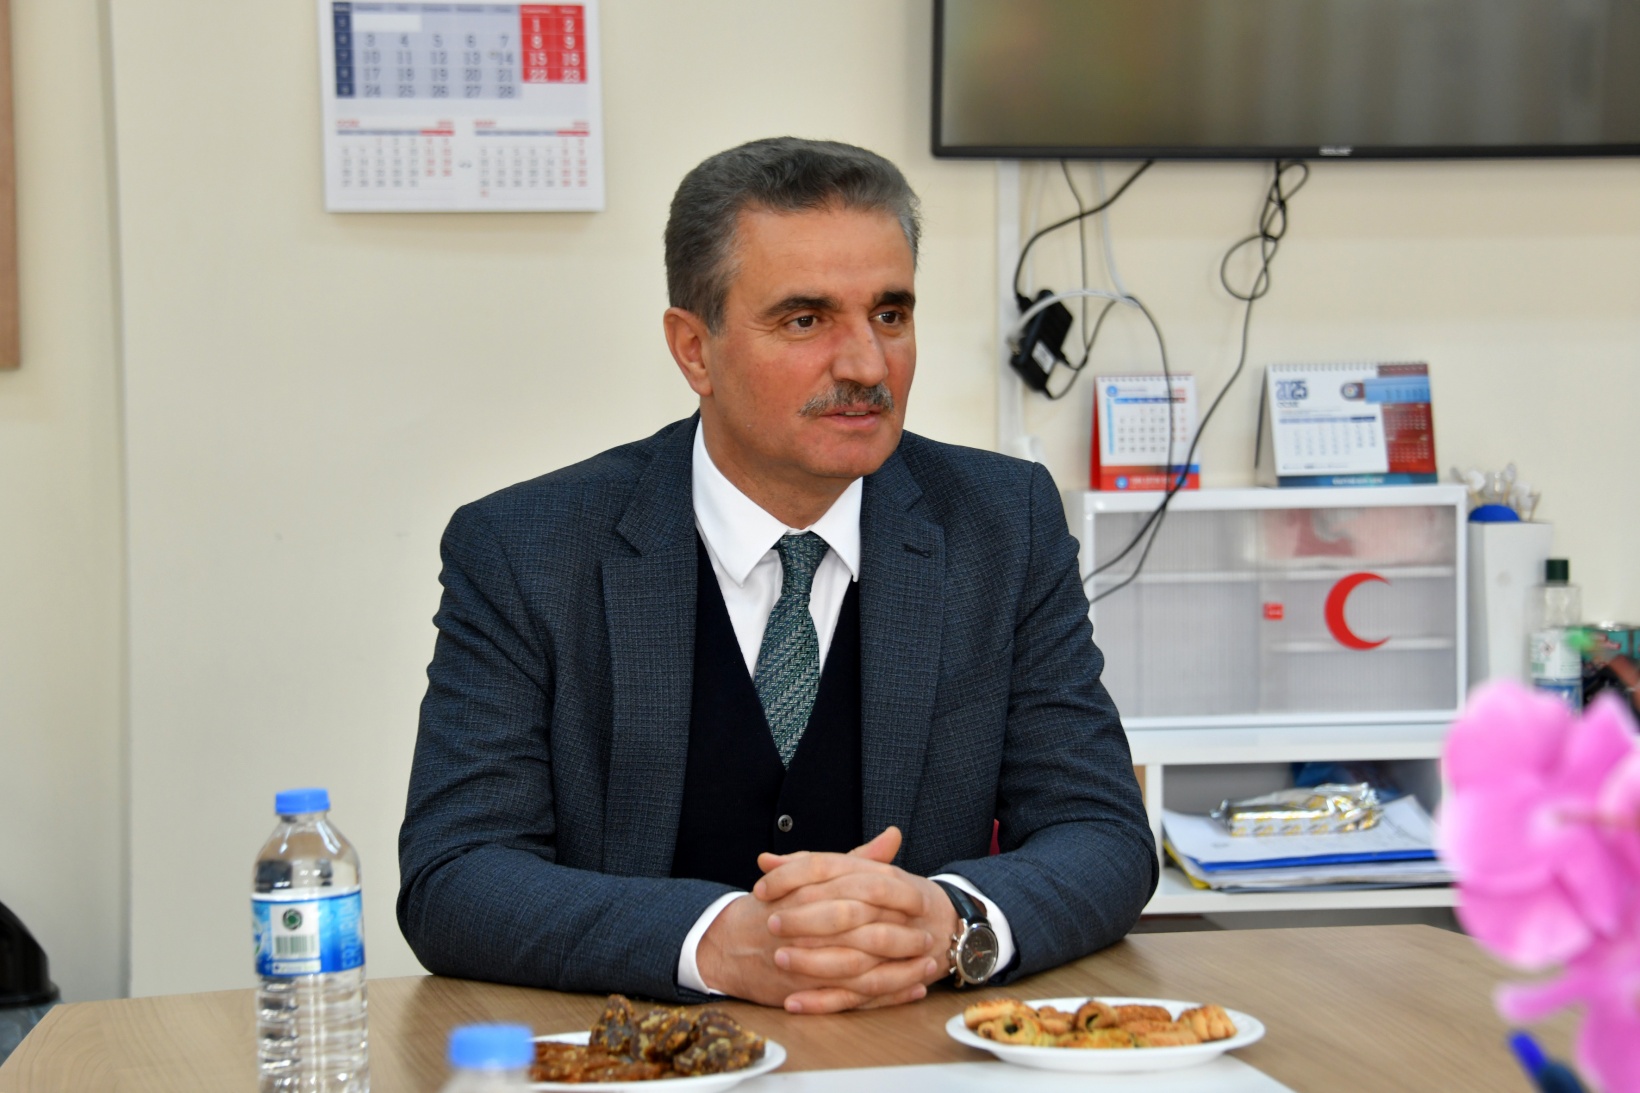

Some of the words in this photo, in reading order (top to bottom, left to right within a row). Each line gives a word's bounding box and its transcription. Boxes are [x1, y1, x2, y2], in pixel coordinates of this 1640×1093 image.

[532, 16, 541, 33] 1
[564, 17, 575, 33] 2
[366, 33, 375, 48] 3
[500, 34, 509, 48] 7
[563, 34, 575, 50] 9
[363, 50, 380, 64] 10
[396, 50, 412, 65] 11
[430, 50, 448, 65] 12
[464, 51, 481, 65] 13
[498, 51, 513, 66] 14
[530, 51, 547, 66] 15
[562, 51, 579, 67] 16
[363, 67, 380, 81] 17
[465, 67, 482, 82] 20
[498, 67, 512, 82] 21
[530, 67, 547, 83] 22
[562, 67, 580, 83] 23
[364, 84, 381, 98] 24
[398, 84, 416, 98] 25
[465, 84, 482, 99] 27
[498, 84, 516, 99] 28
[1275, 380, 1308, 400] 2025
